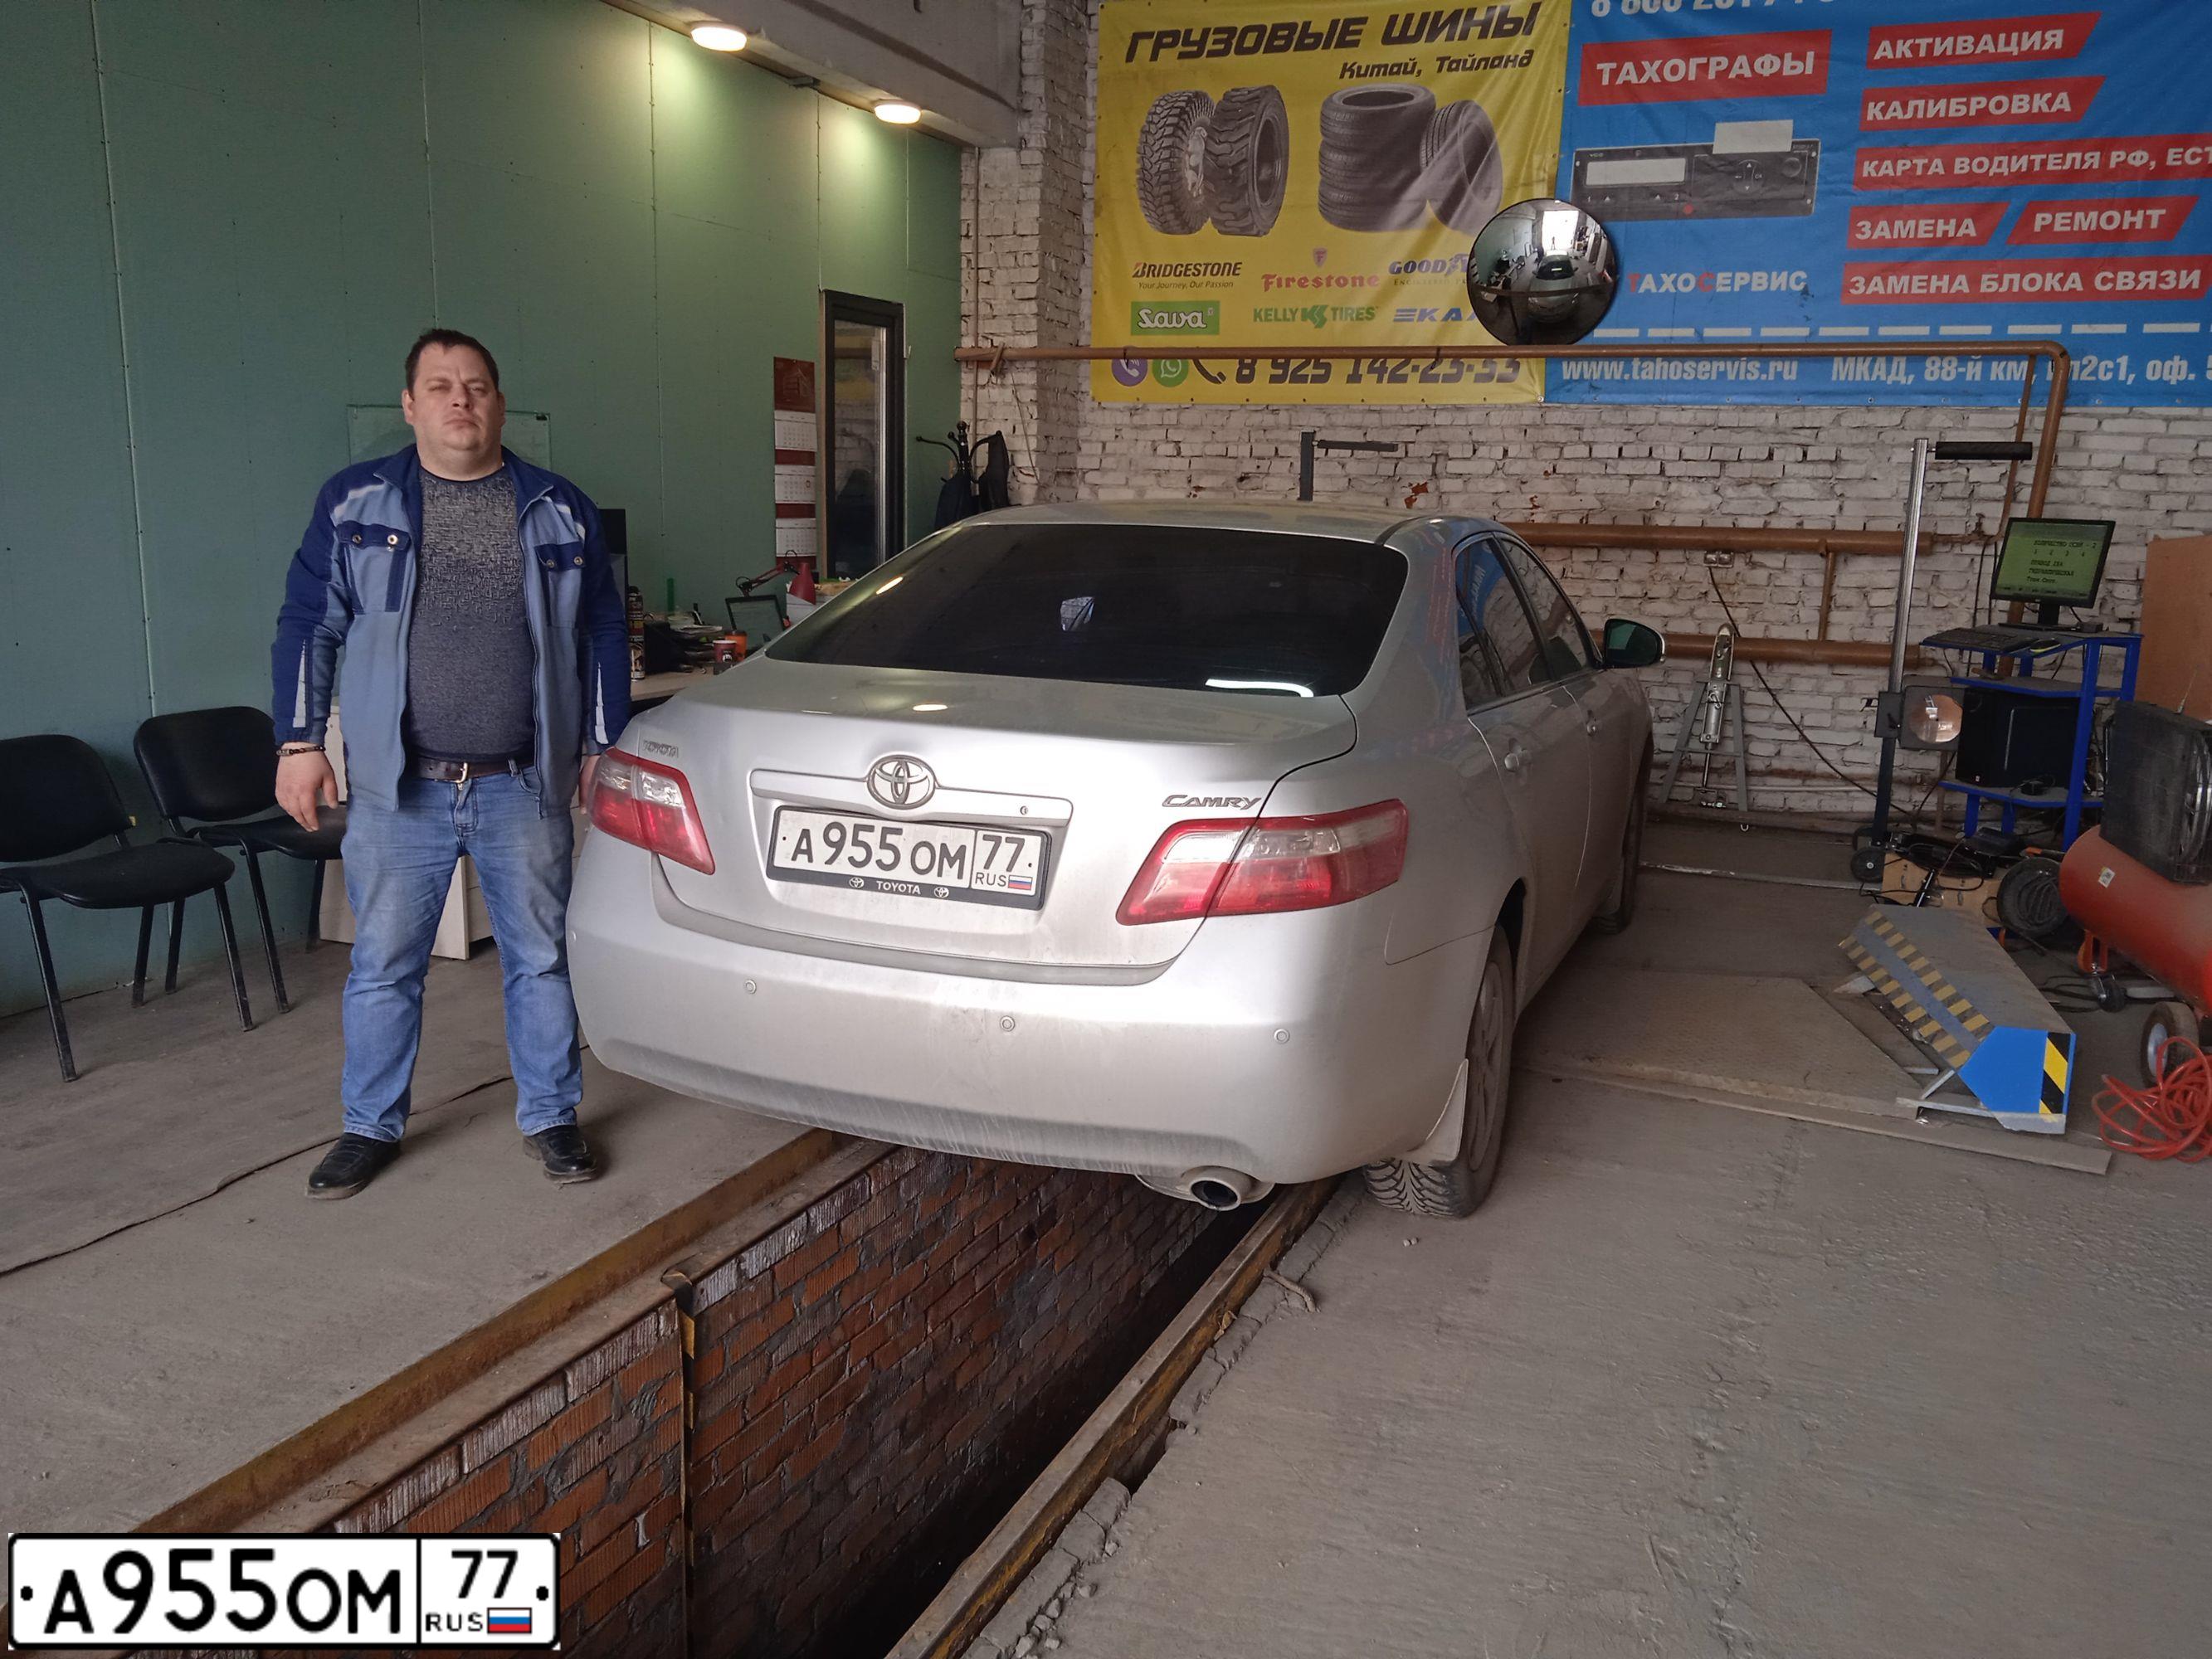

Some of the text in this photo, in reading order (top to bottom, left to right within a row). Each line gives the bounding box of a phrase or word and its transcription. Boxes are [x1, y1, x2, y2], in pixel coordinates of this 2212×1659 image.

[1125, 2, 1542, 63] ГРУЗОВЫЕ ШИНЫ
[1873, 29, 2064, 61] АКТИВАЦИЯ
[1339, 49, 1534, 79] Китай, Тайланд
[1596, 51, 1815, 86] ТАХОГРАФЫ
[1866, 92, 2072, 121] КАЛИБРОВКА
[1862, 158, 1946, 178] КАРТА
[1953, 151, 2101, 177] ВОДИТЕЛЯ
[2109, 149, 2156, 172] РФ,
[1855, 217, 1977, 241] ЗАМЕНА
[2034, 209, 2166, 232] РЕМОНТ
[1132, 262, 1243, 279] BRIDGESTONE
[1627, 270, 1808, 294] ТАХОСЕРВИС
[1849, 270, 2201, 294] ЗАМЕНА БЛОКА СВЯЗИ
[1205, 280, 1234, 289] Passion
[1261, 273, 1381, 293] Firestone
[1138, 308, 1207, 329] Sava
[1253, 306, 1376, 323] KELLY TIRES
[1562, 357, 1798, 382] www.tahoservis.ru
[1832, 355, 1915, 385] МКАД,
[1924, 355, 1983, 382] 88-й
[2146, 355, 2195, 385] оф.
[1162, 794, 1262, 810] CAMRY
[982, 834, 1026, 873] 77
[876, 881, 921, 895] TOYOTA
[975, 872, 1007, 888] RUS
